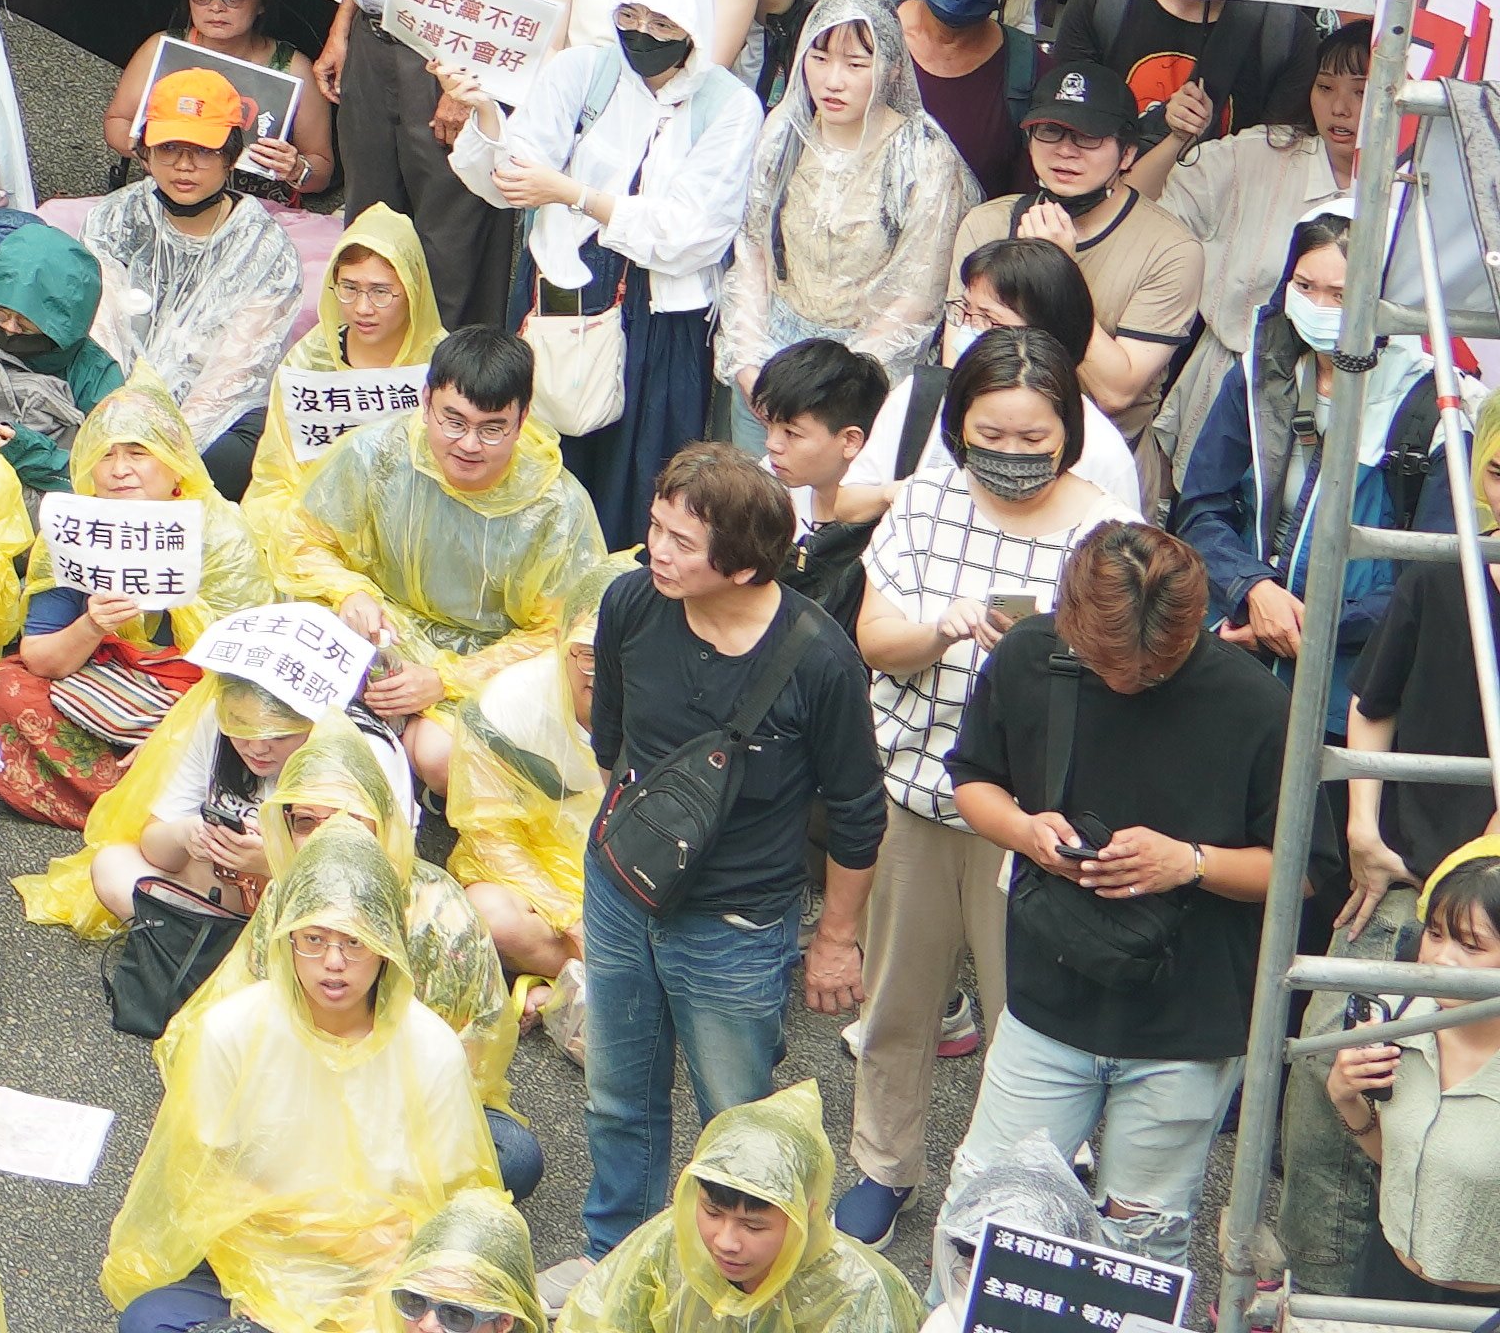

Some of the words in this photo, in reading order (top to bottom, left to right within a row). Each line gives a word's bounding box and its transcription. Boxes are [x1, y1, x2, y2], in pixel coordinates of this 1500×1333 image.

[394, 7, 526, 75] 台灣不會好
[292, 384, 419, 412] 沒有討論
[54, 516, 184, 551] 沒有討論
[59, 560, 185, 594] 沒有民主
[224, 616, 355, 674] 民主已死
